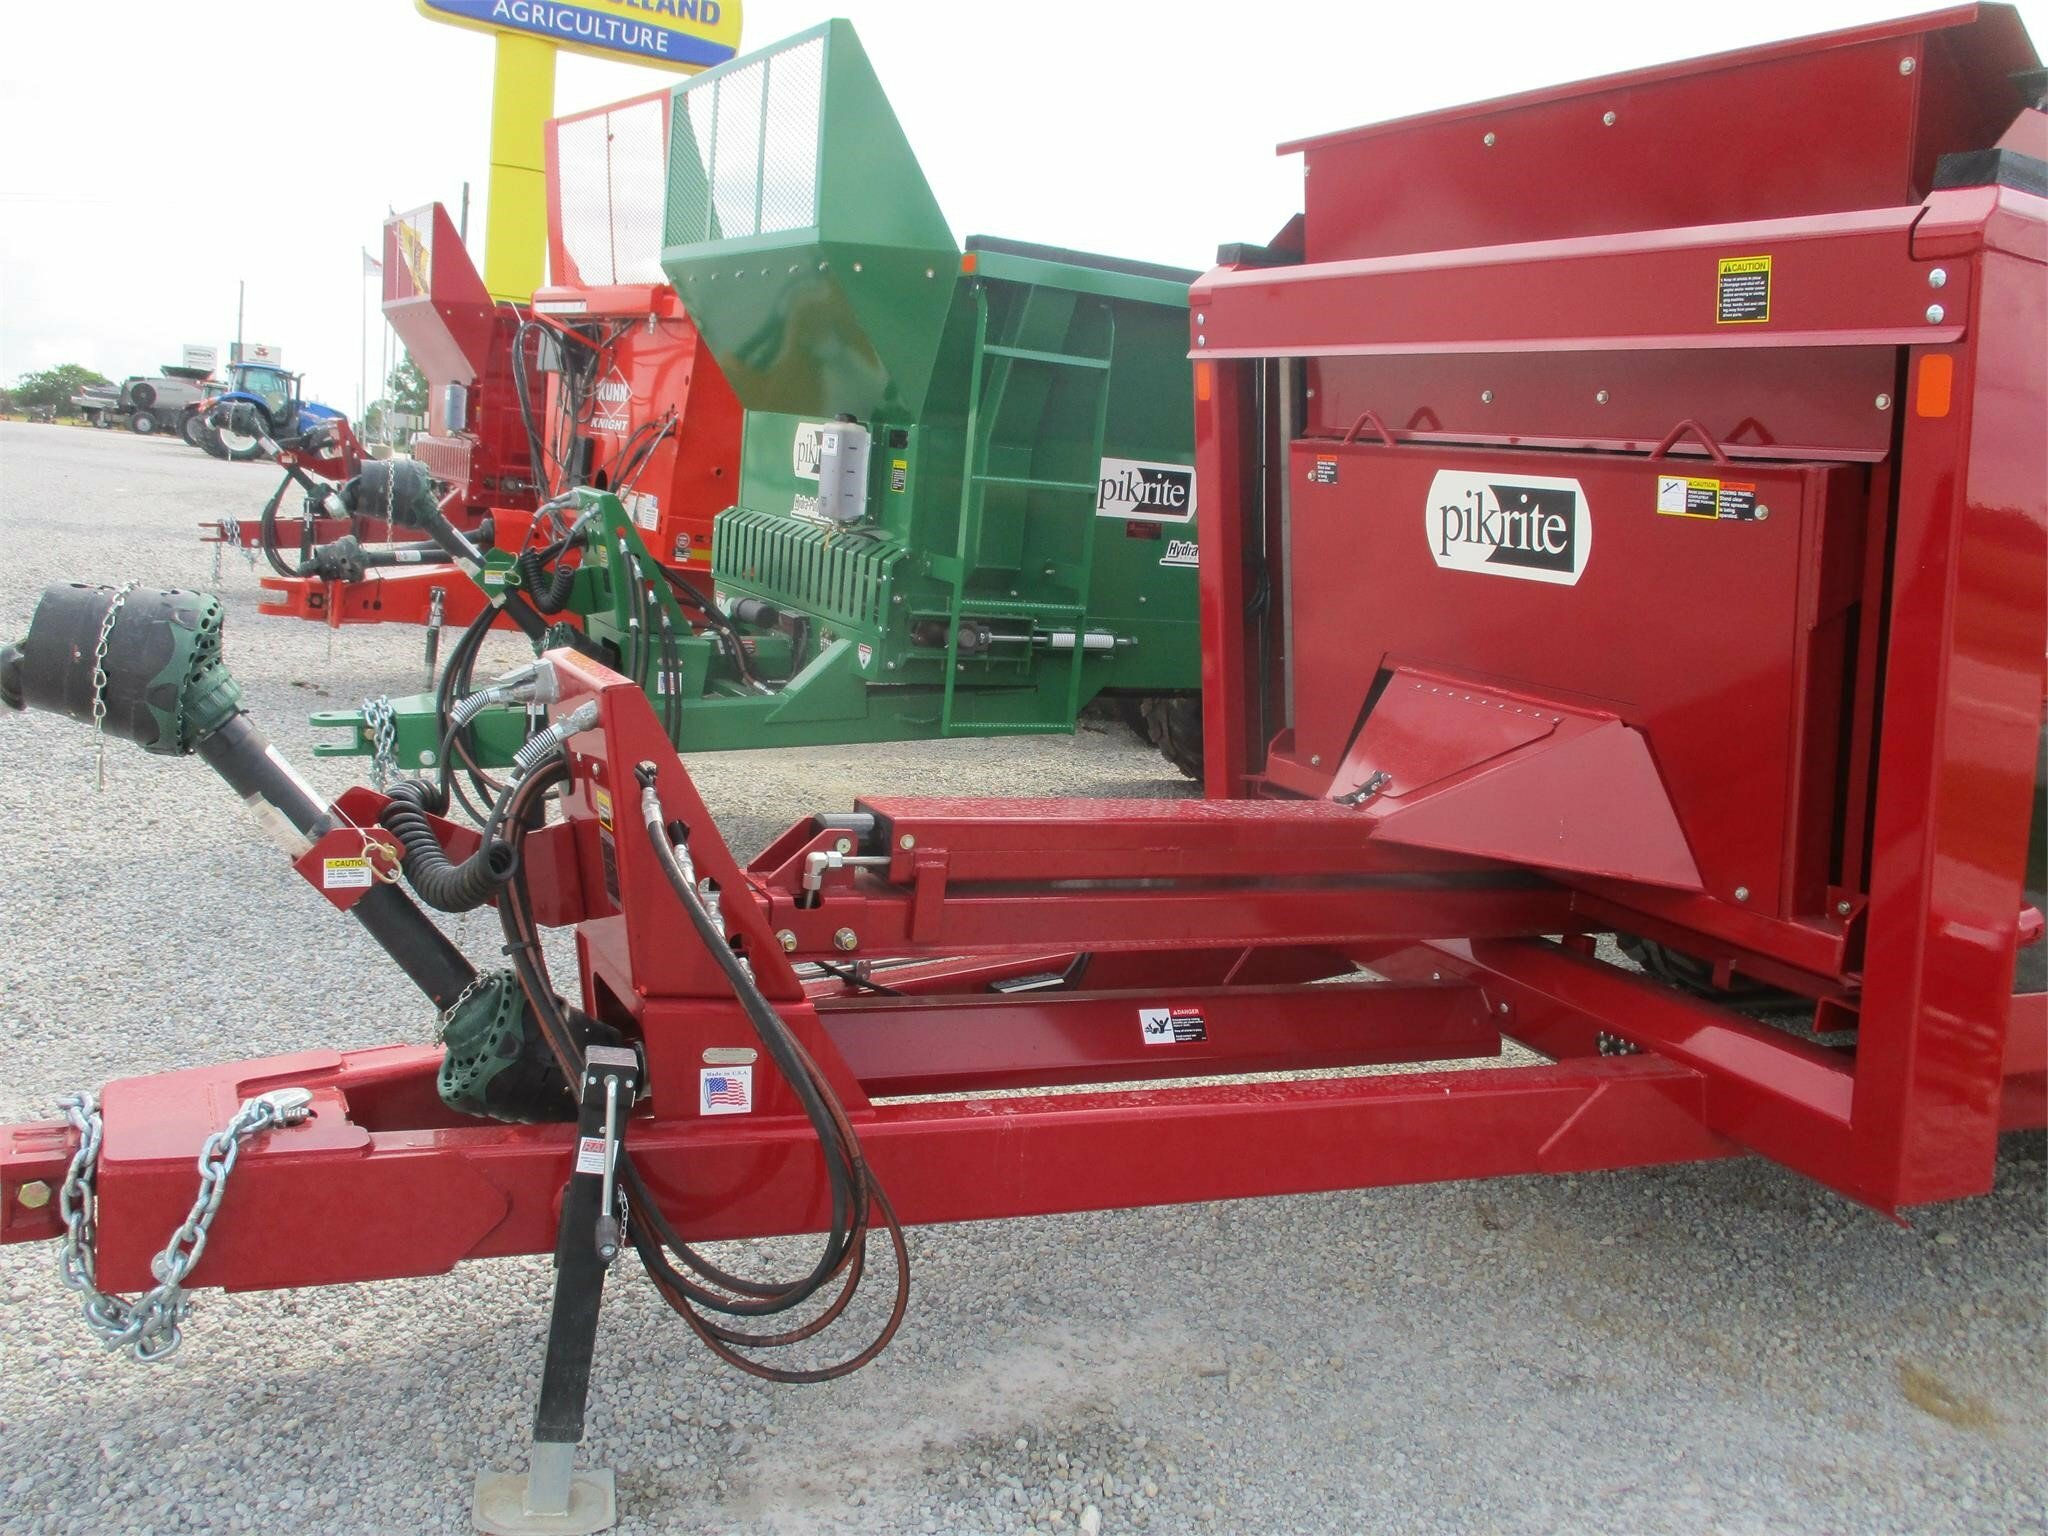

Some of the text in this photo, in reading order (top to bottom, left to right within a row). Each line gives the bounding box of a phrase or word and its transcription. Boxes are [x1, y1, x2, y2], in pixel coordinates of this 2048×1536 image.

[493, 0, 668, 52] AGRICULTURE
[1731, 262, 1766, 272] CAUTION
[597, 383, 627, 402] KUHN
[591, 417, 628, 432] KNIGHT
[1098, 470, 1185, 510] pikrite
[1693, 481, 1717, 489] CAUTION
[1439, 489, 1568, 556] pikrite
